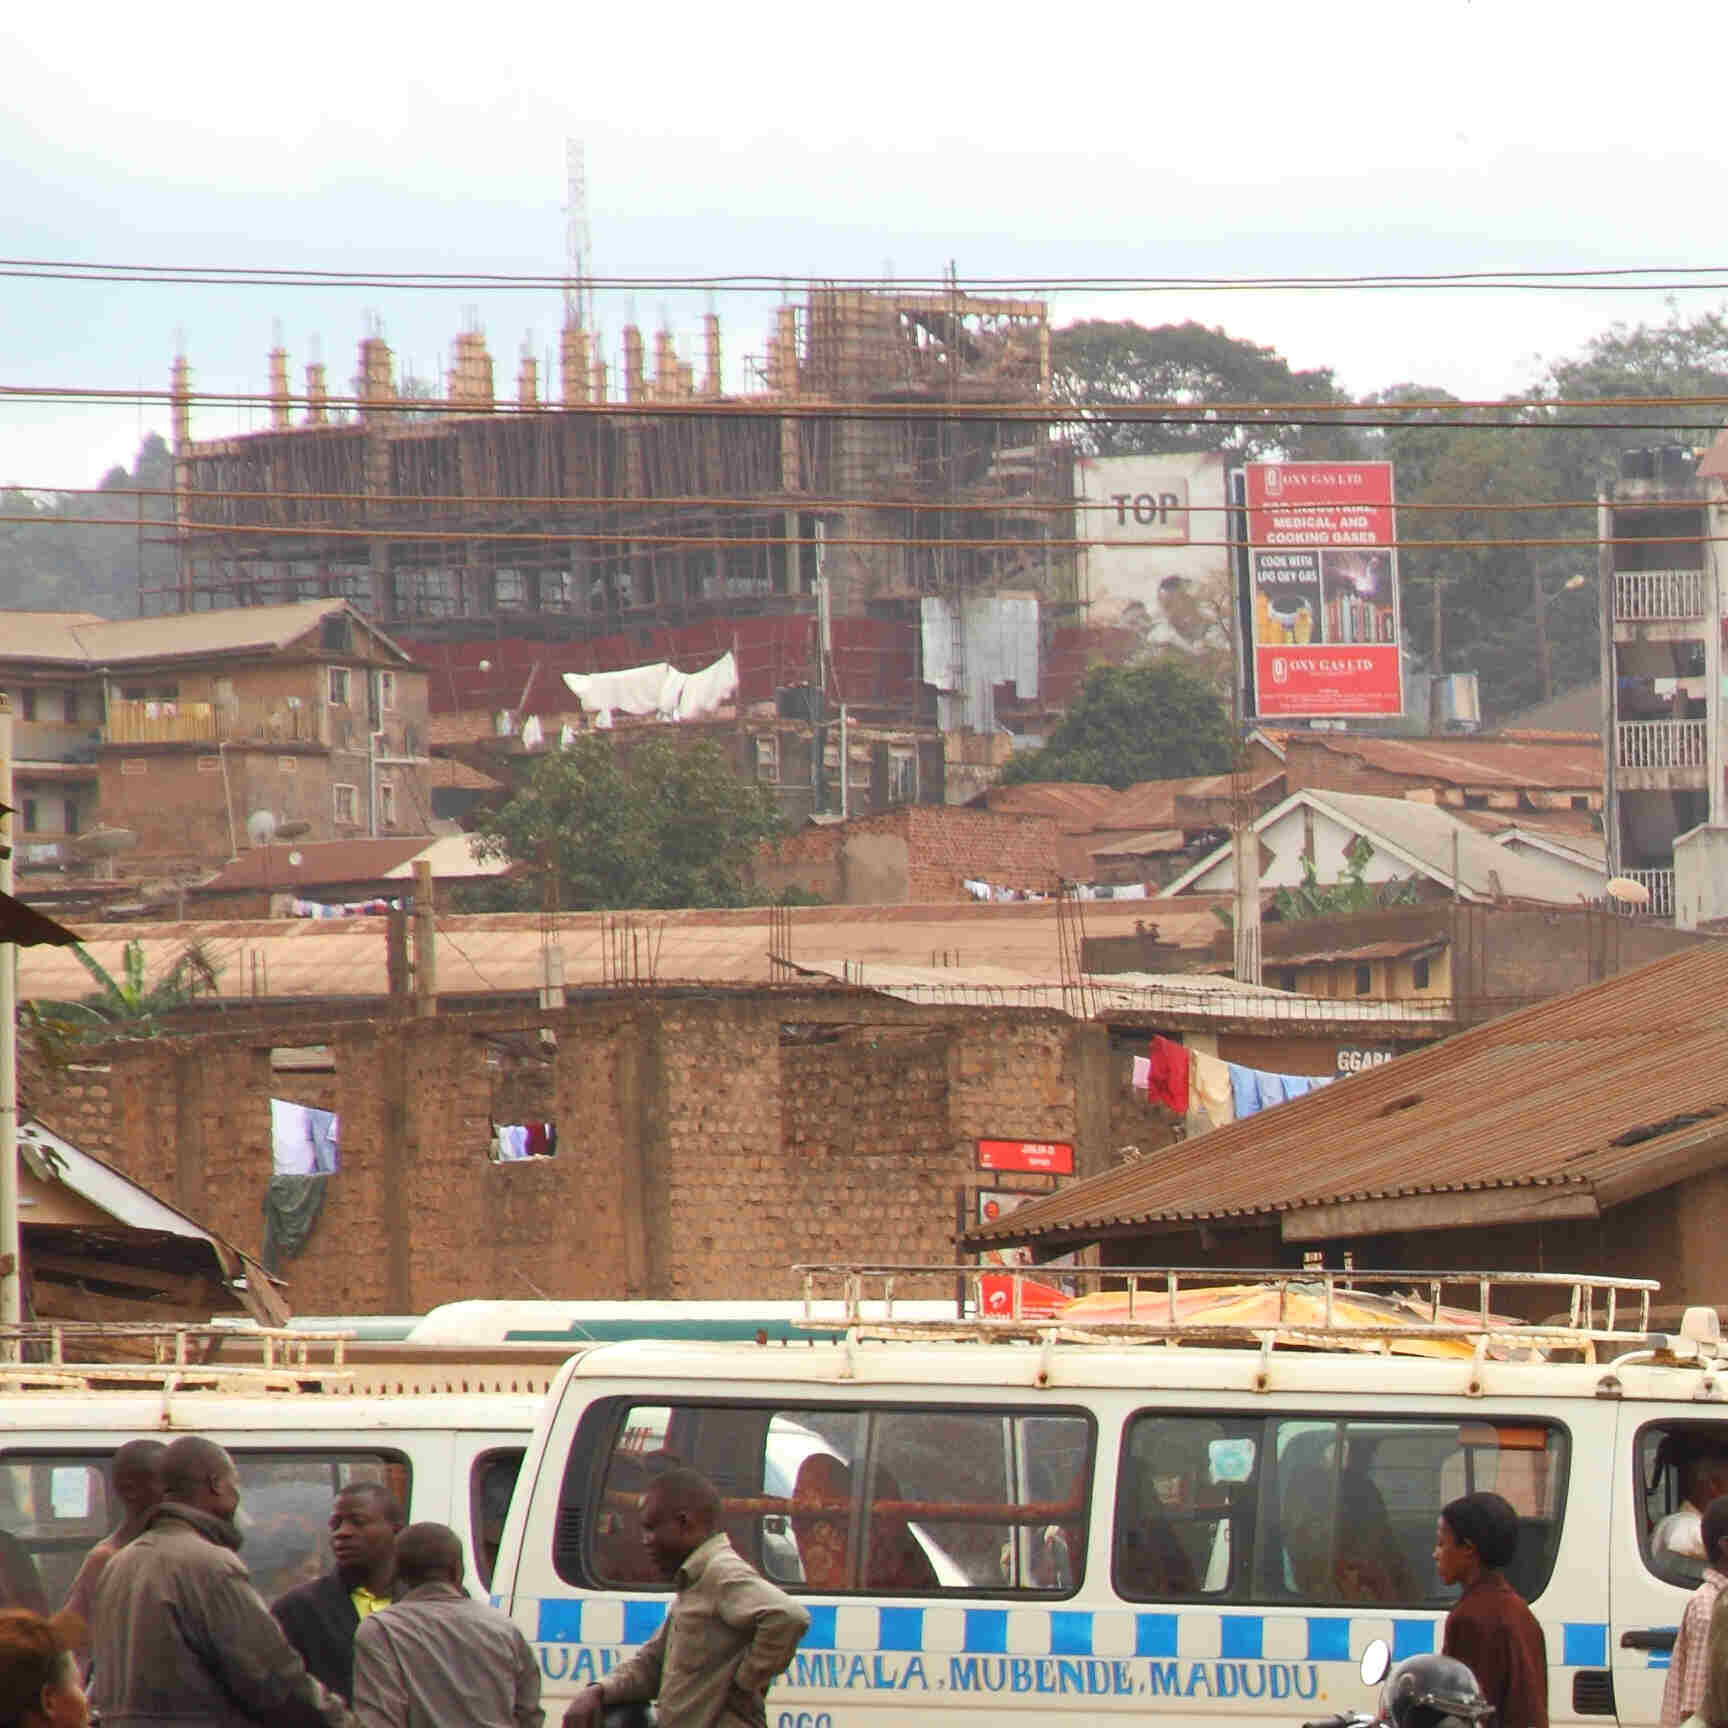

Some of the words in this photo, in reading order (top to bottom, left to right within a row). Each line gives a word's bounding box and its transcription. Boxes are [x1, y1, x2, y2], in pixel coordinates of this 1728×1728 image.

[1311, 473, 1336, 485] GAS
[1111, 493, 1179, 526] TOP
[1340, 516, 1368, 529] AND
[1266, 532, 1329, 545] COOKING
[1331, 531, 1376, 544] GASES
[1288, 555, 1313, 567] WITH
[1319, 659, 1344, 671] GAS
[1346, 658, 1373, 671] LTD
